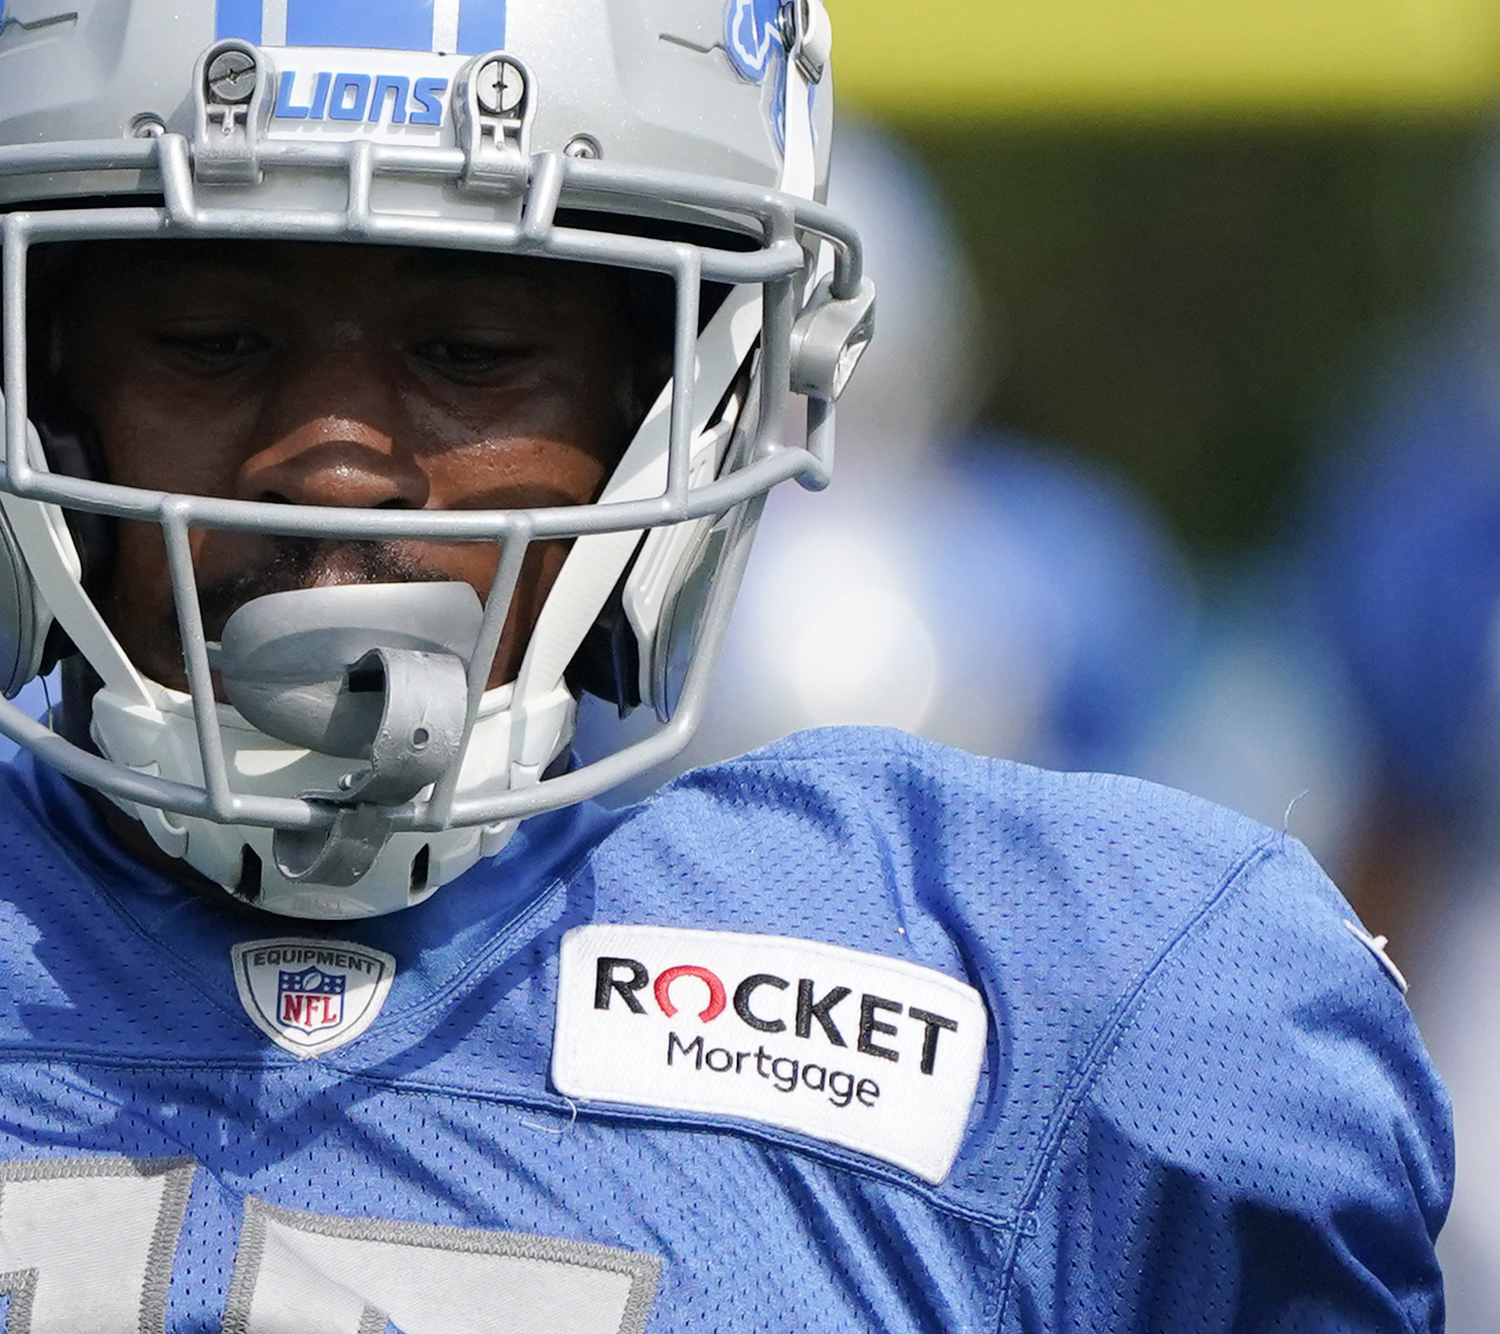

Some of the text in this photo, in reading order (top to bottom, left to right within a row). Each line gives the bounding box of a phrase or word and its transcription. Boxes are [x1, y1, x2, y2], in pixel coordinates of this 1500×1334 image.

[275, 71, 449, 126] LIONS
[253, 950, 377, 975] EQUIPMENT
[282, 994, 337, 1027] NFL
[594, 956, 959, 1076] ROCKET
[666, 1031, 881, 1108] Mortgage
